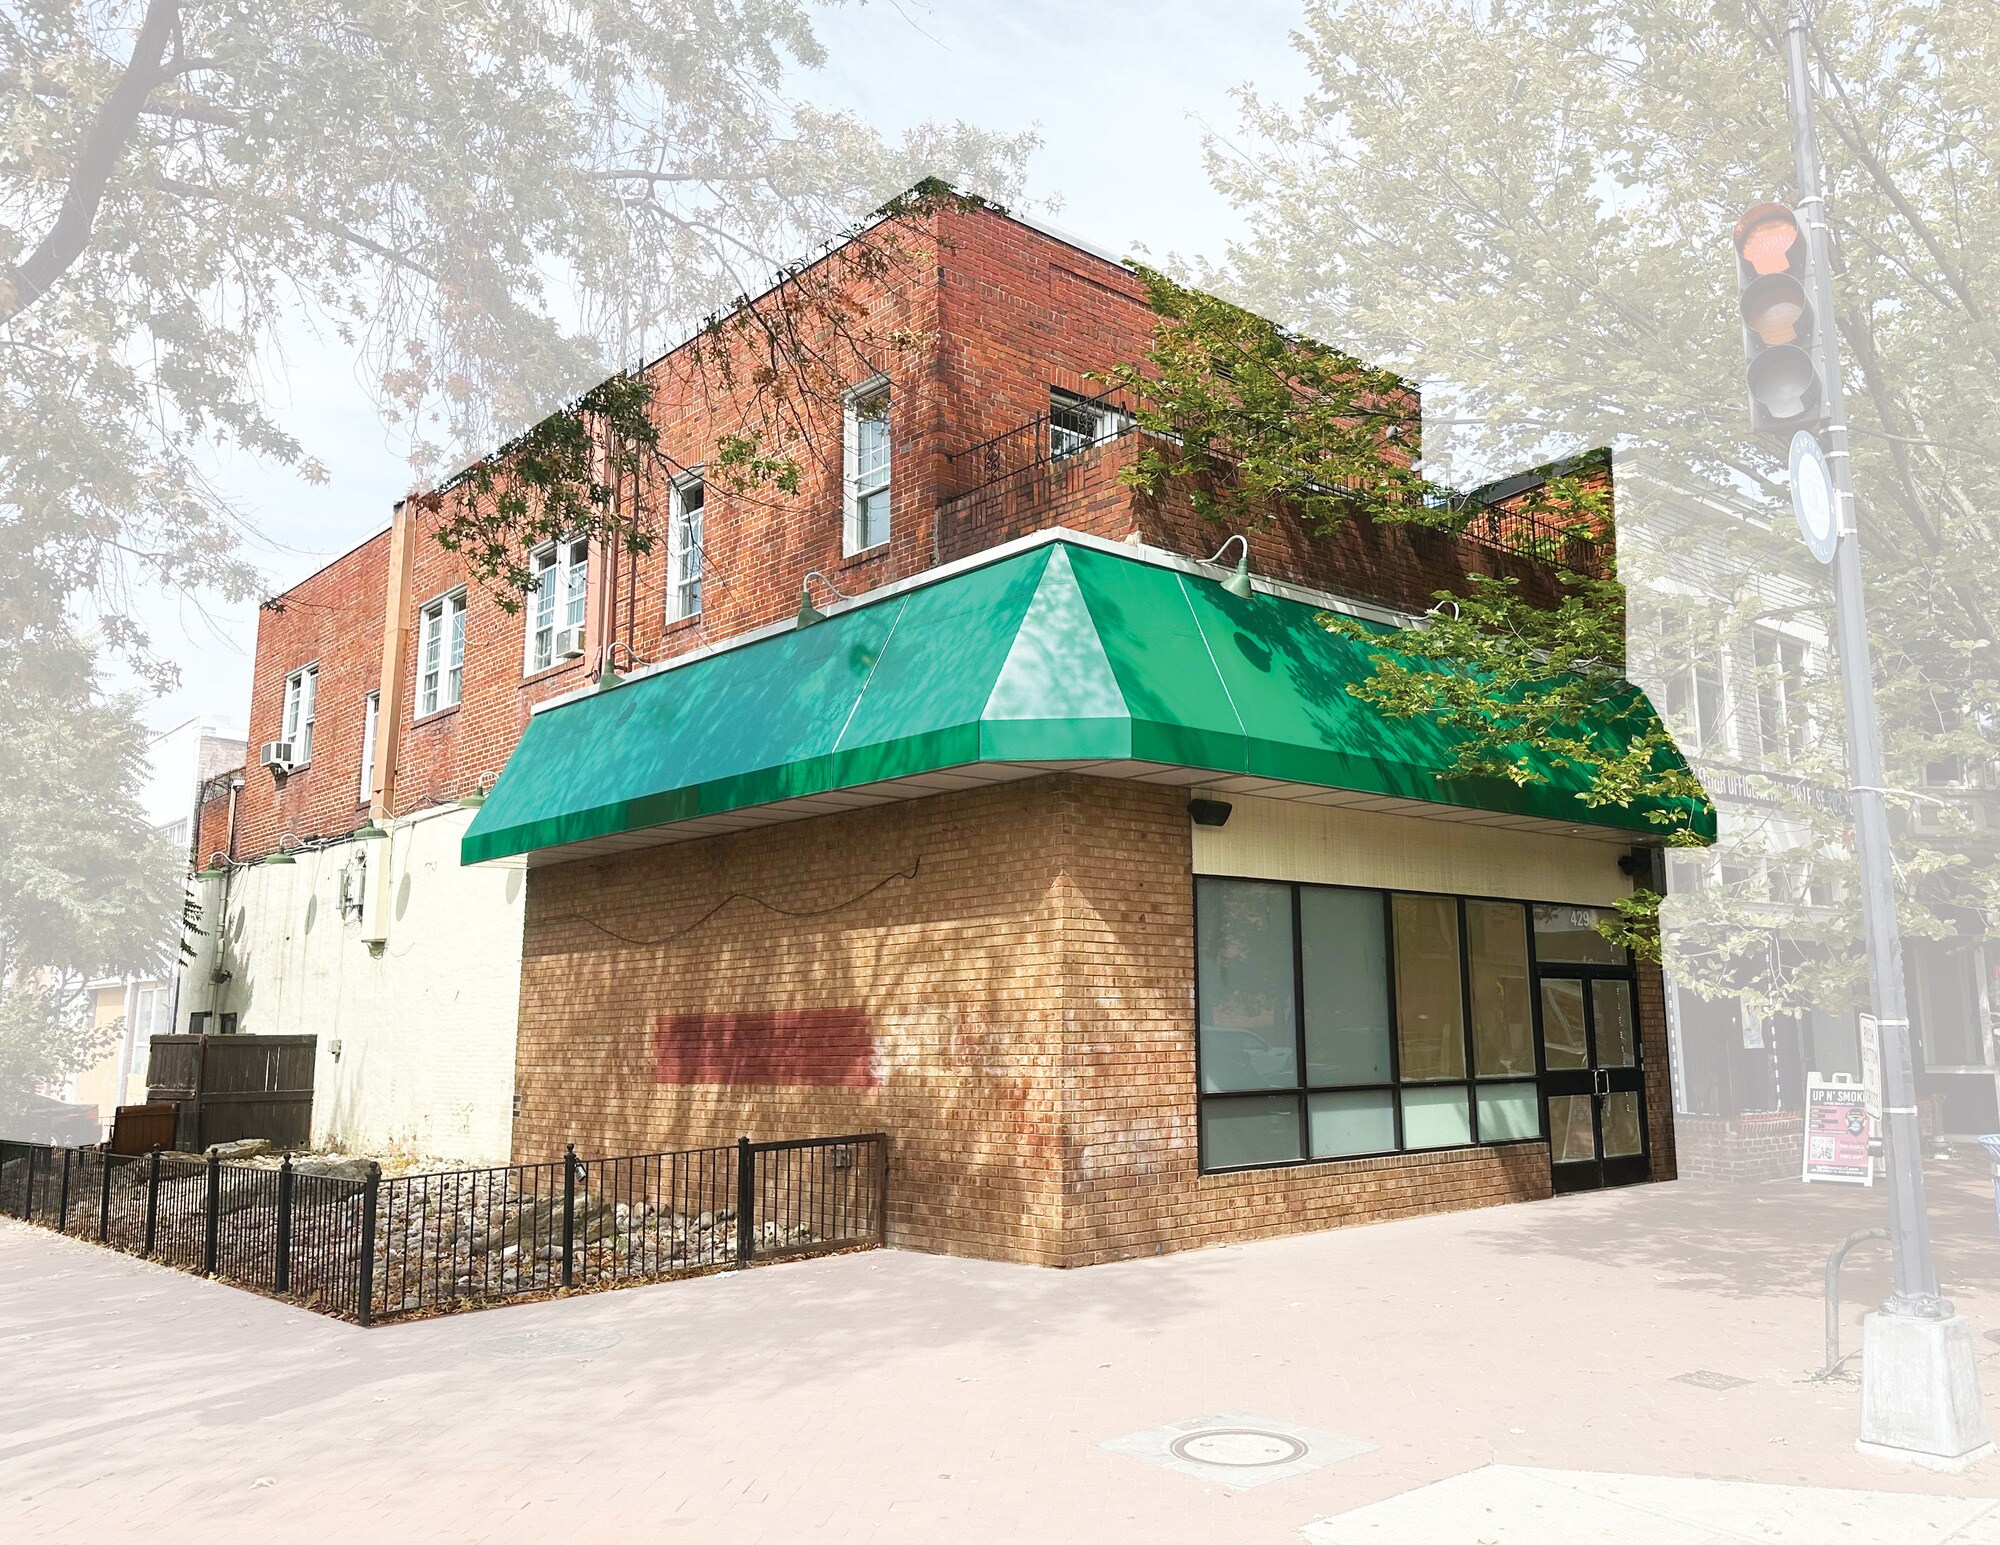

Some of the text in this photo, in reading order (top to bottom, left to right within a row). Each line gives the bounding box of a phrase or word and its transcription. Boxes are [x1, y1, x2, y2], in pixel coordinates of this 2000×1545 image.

[1795, 438, 1825, 472] CAPITOL
[1811, 538, 1829, 556] HILL
[1570, 911, 1590, 927] 429
[1812, 1090, 1825, 1101] UP
[1837, 1090, 1865, 1103] SMOK
